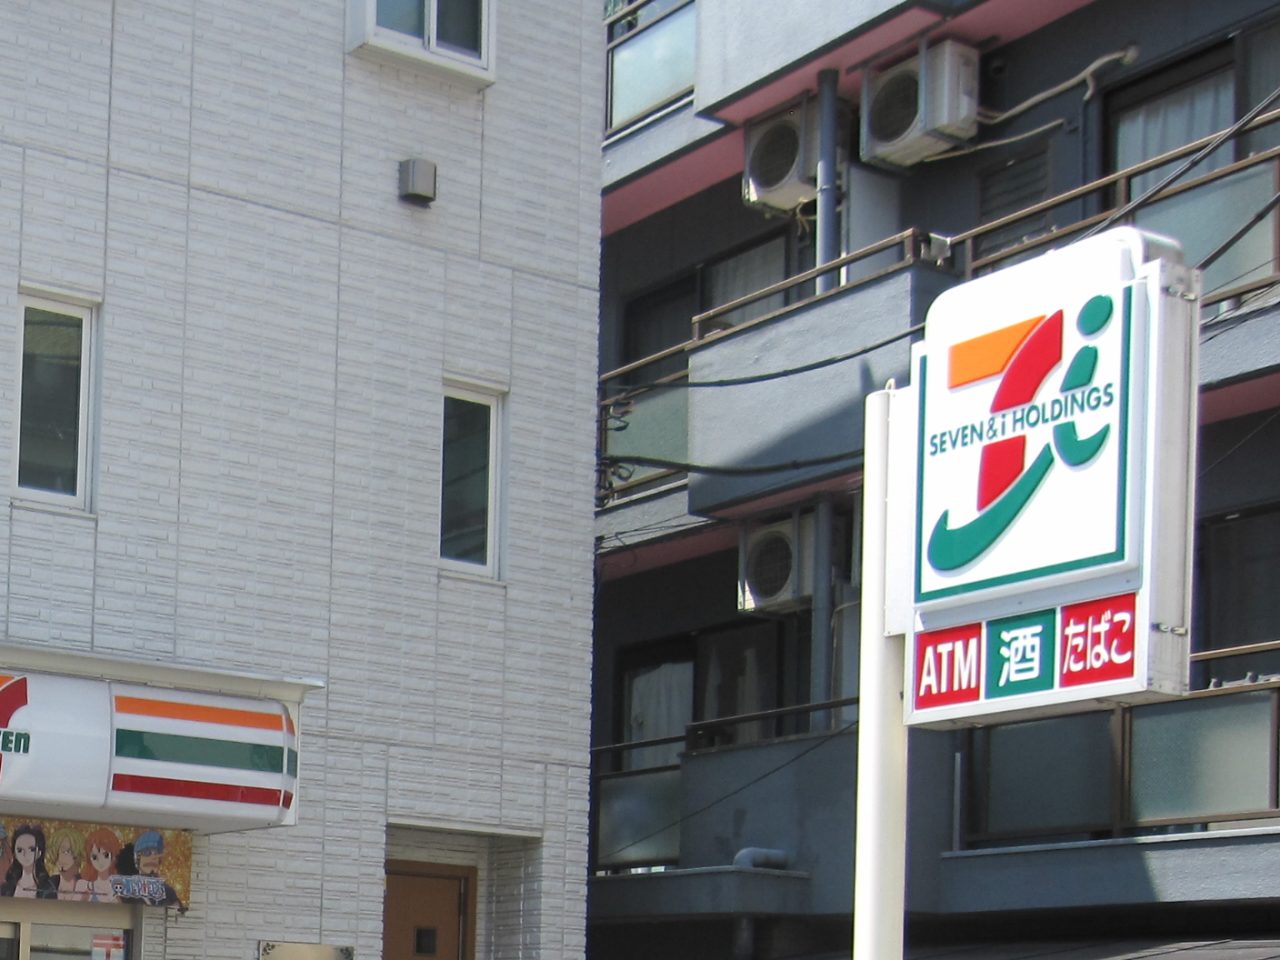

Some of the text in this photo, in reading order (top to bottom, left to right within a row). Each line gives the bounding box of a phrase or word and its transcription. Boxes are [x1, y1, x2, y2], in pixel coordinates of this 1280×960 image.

[1011, 382, 1115, 434] HOLDINGS
[919, 610, 1133, 698] ATM 酒 たばこ
